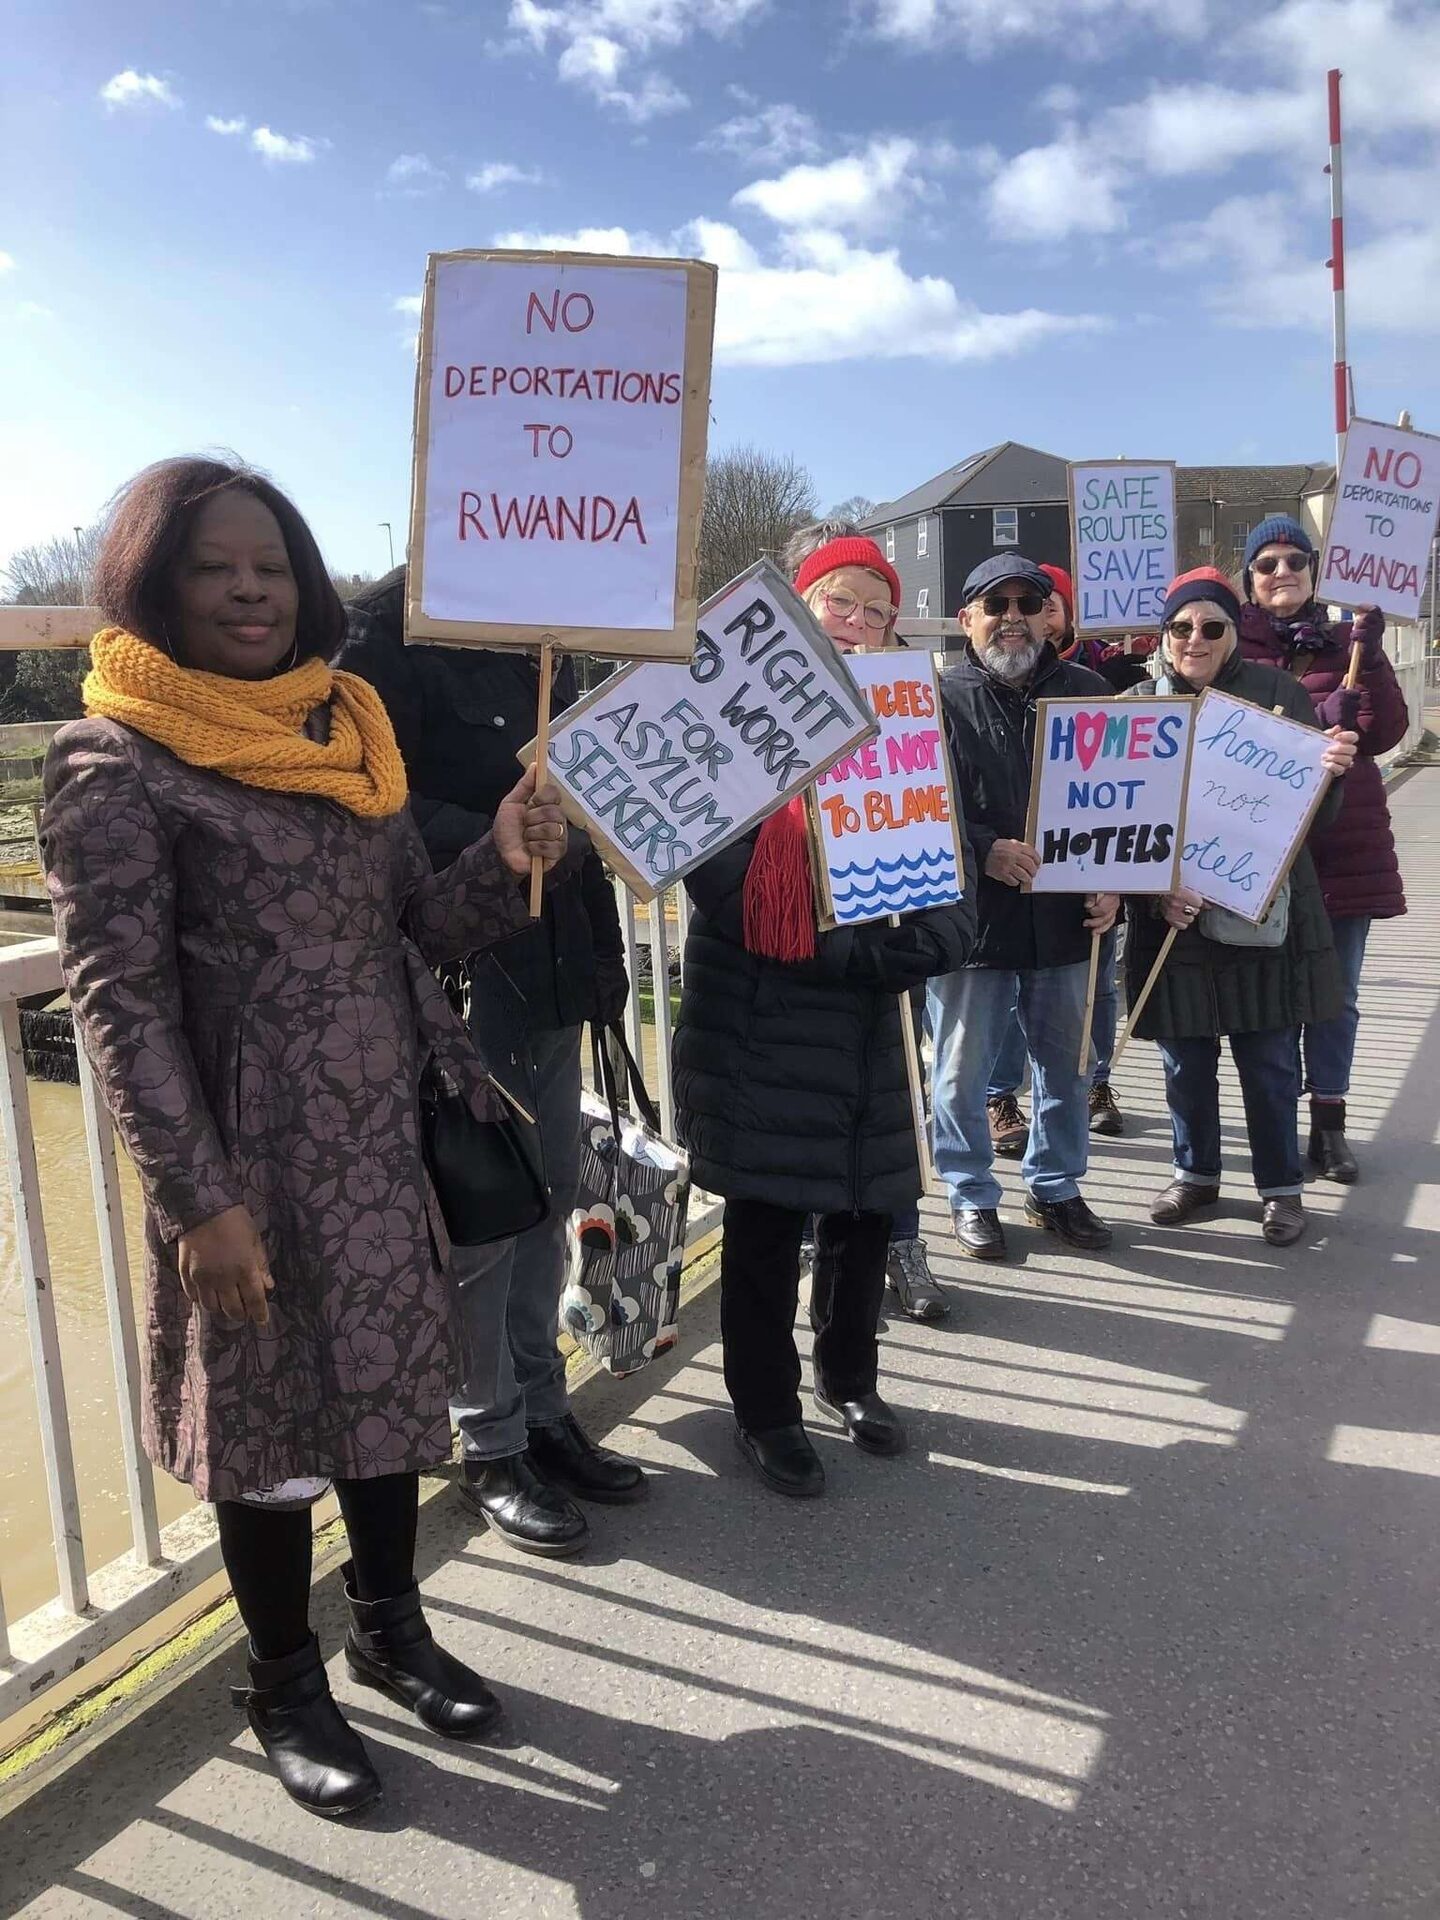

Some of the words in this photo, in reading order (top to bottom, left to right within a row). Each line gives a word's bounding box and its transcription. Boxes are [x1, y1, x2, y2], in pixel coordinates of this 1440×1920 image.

[526, 289, 594, 334] NO
[444, 365, 681, 404] DEPORTATIONS
[523, 424, 573, 458] TO
[1363, 447, 1422, 489] NO
[1082, 476, 1160, 511] SAFE
[1342, 484, 1433, 514] DEPORTATIONS
[458, 491, 647, 545] RWANDA
[1078, 514, 1168, 543] ROUTES
[1365, 514, 1395, 537] TO
[1083, 547, 1165, 582] SAVE
[1325, 545, 1418, 597] RWANDA
[1083, 586, 1167, 621] LIVES
[723, 598, 855, 739] RIGHT
[661, 698, 734, 782] FOR
[719, 681, 811, 791] WORK
[885, 730, 940, 776] NOT
[1050, 711, 1183, 772] HOMES
[1199, 709, 1313, 790] homes
[594, 702, 734, 848] ASYLUM
[1067, 780, 1146, 810] NOT
[547, 729, 693, 879] SEEKERS
[821, 794, 861, 838] TO
[863, 784, 950, 832] BLAME
[1201, 780, 1271, 824] not
[1042, 823, 1174, 866] HOTELS
[1181, 836, 1260, 892] otels
